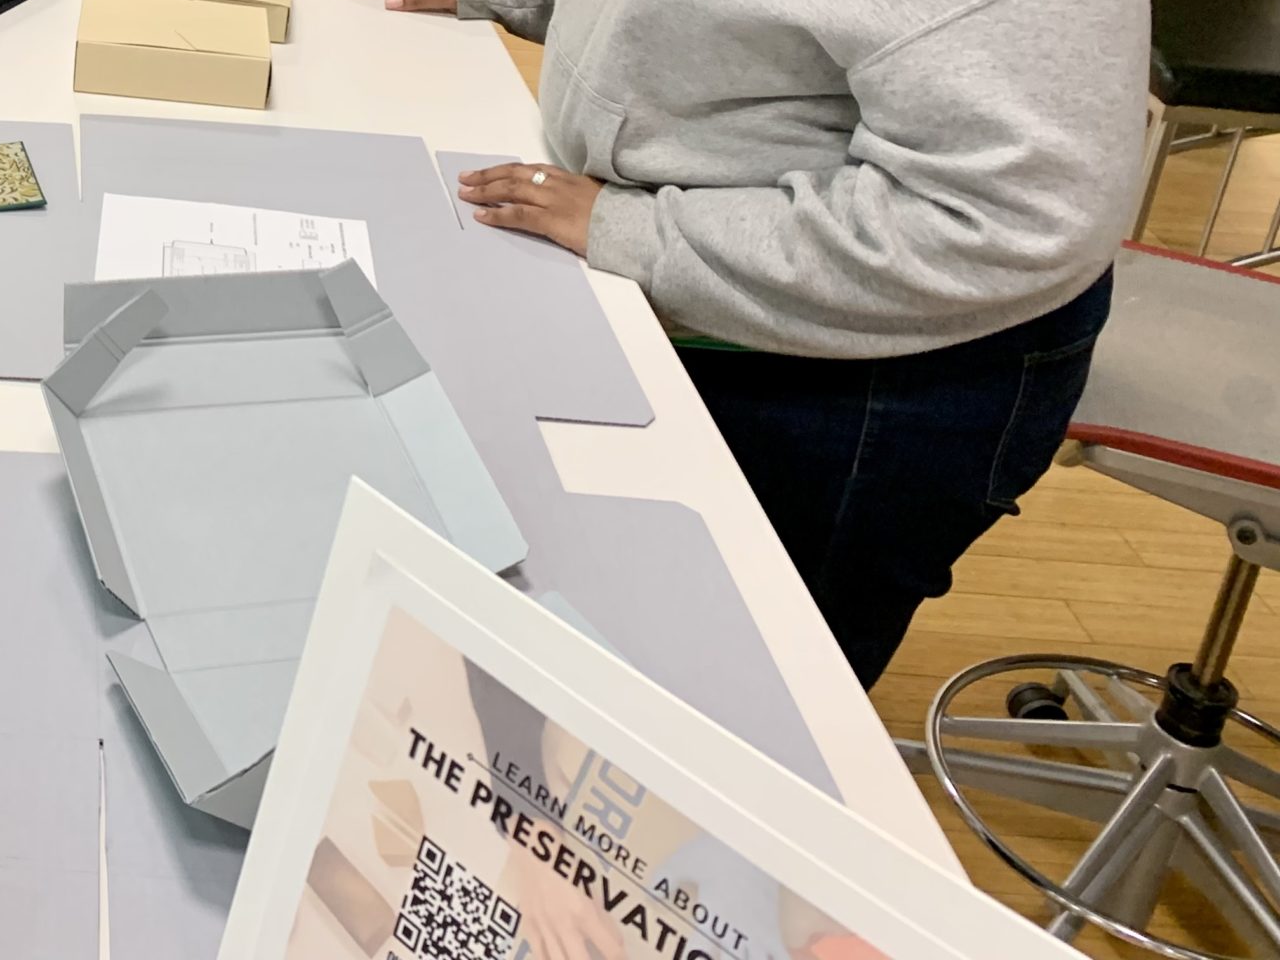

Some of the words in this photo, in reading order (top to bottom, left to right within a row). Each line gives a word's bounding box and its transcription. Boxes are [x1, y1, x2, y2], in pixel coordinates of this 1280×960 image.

[407, 727, 465, 794] THE
[492, 751, 569, 820] LEARN
[573, 814, 650, 881] MORE
[653, 877, 749, 950] ABOUT
